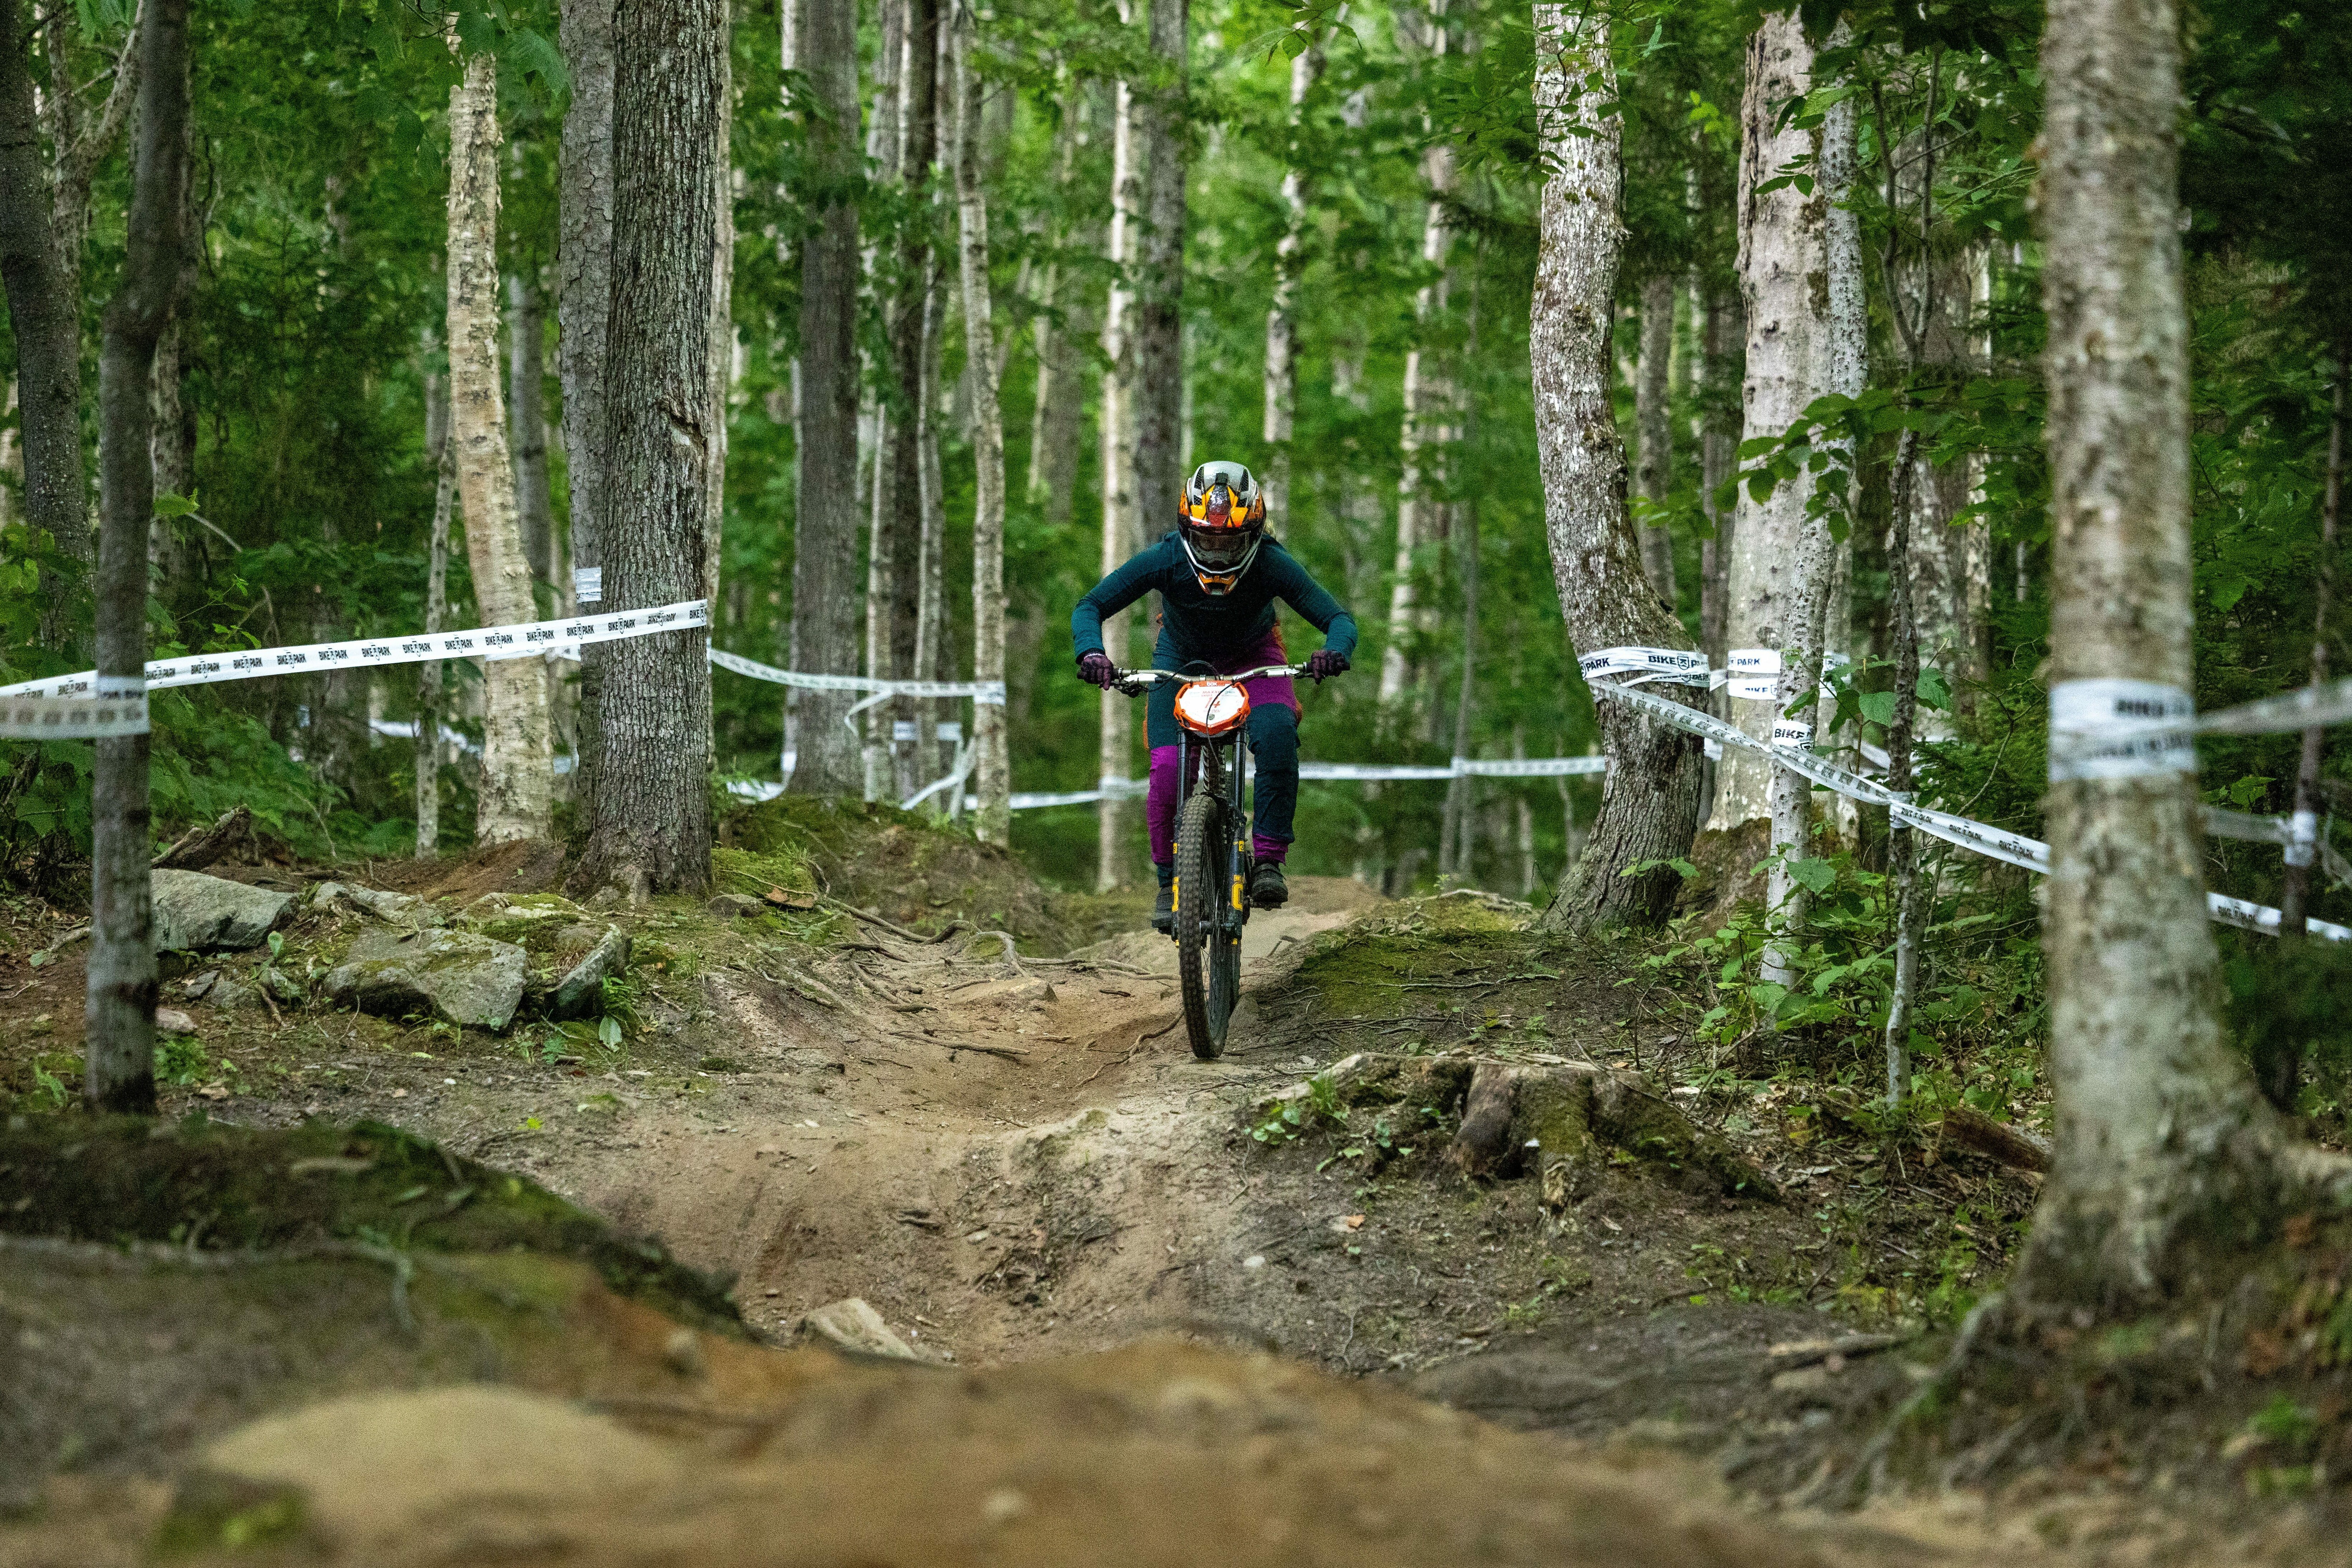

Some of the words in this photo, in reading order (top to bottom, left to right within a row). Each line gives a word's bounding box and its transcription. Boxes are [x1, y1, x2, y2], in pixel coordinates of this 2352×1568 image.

[689, 610, 700, 619] BIKE
[566, 627, 578, 636] BIKE
[582, 625, 594, 635] PARK
[608, 622, 618, 631] BIKE
[623, 619, 635, 629] PARK
[485, 636, 497, 645] BIKE
[501, 634, 514, 644] PARK
[526, 632, 538, 641] BIKE
[542, 630, 555, 640] PARK
[402, 644, 415, 653] BIKE
[418, 643, 432, 652] PARK
[444, 641, 457, 650] BIKE
[460, 639, 474, 649] PARK
[318, 651, 330, 660] BIKE
[334, 650, 349, 659] PARK
[361, 648, 374, 657] BIKE
[377, 646, 391, 656] PARK
[276, 655, 287, 665] BIKE
[293, 654, 307, 664] PARK
[1587, 657, 1610, 672] PARK
[1648, 655, 1676, 664] BIKE
[1774, 728, 1805, 739] BIKE
